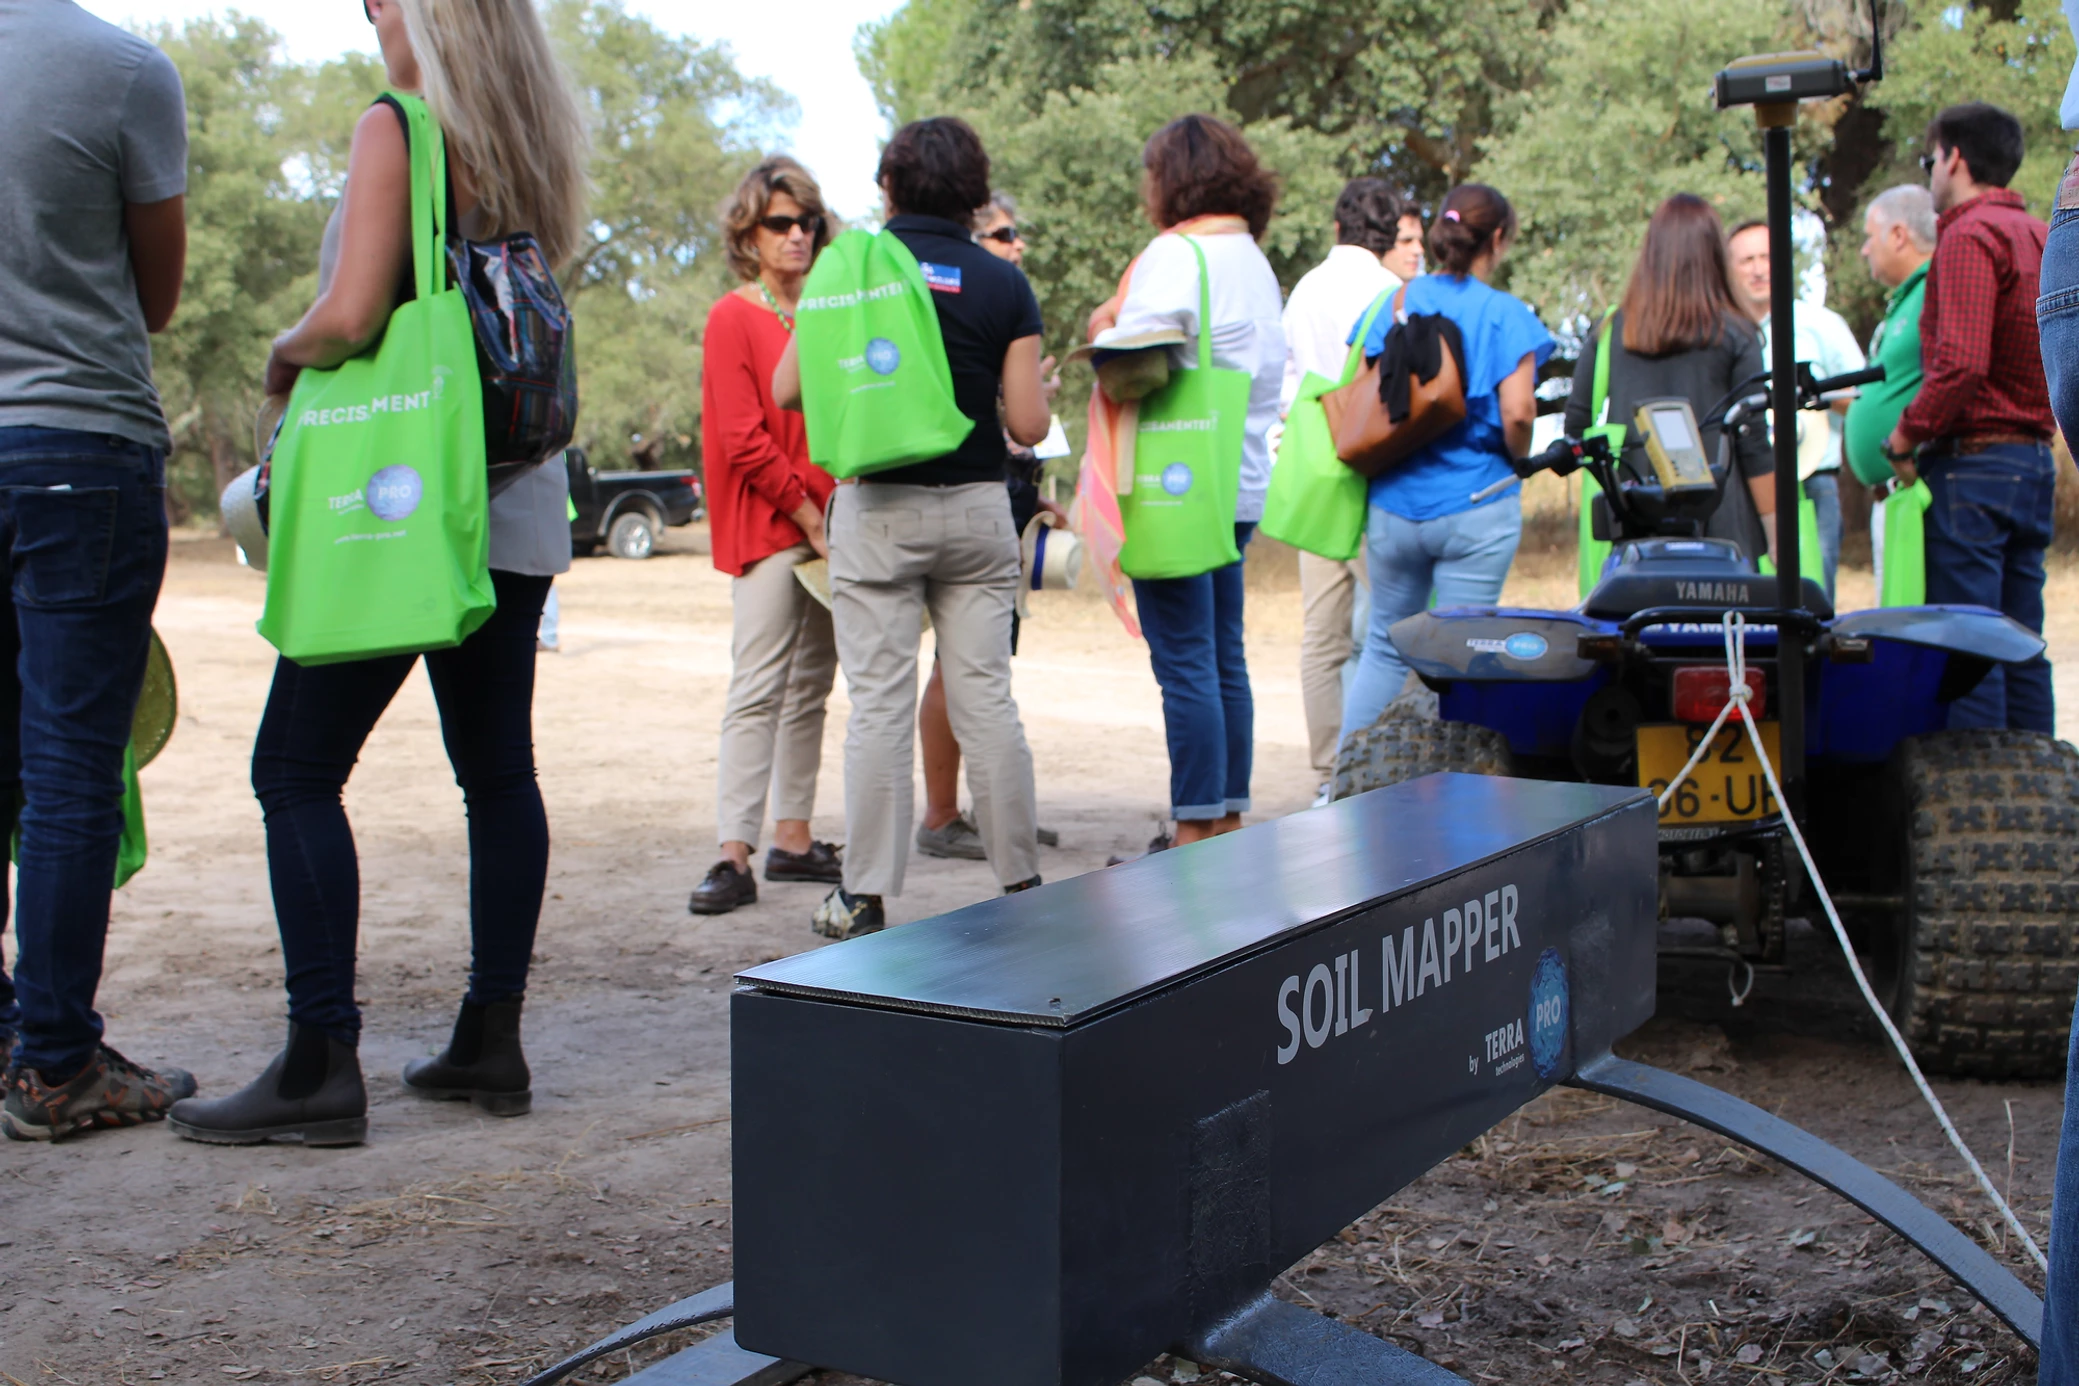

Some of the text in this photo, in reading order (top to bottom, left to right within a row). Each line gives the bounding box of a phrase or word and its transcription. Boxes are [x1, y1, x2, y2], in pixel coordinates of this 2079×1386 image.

[378, 484, 412, 500] PRO
[1676, 581, 1750, 603] YAMAHA
[1277, 883, 1522, 1065] SOIL MAPPER
[1469, 995, 1561, 1076] by TERRA PRO
[1495, 1053, 1525, 1077] technologies
